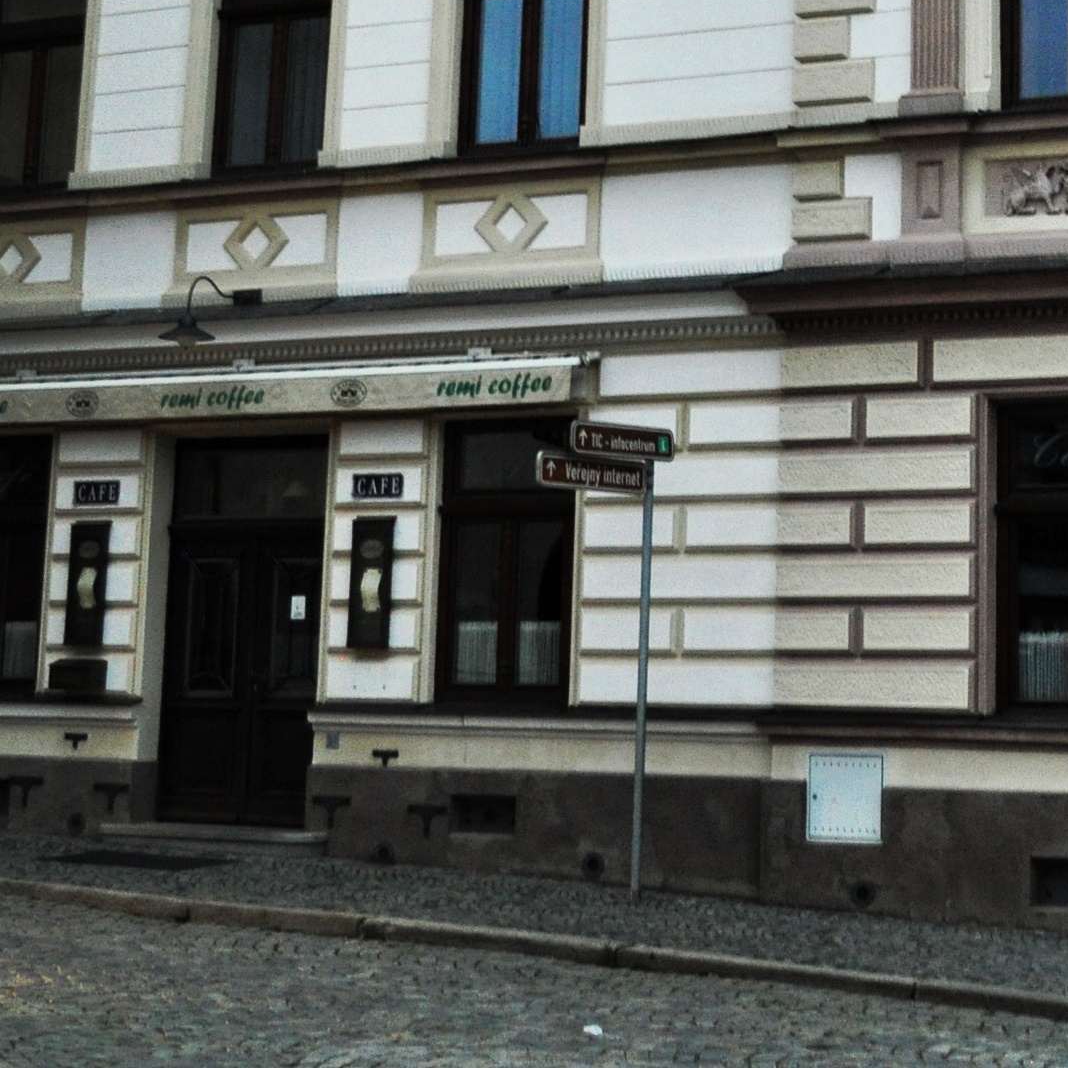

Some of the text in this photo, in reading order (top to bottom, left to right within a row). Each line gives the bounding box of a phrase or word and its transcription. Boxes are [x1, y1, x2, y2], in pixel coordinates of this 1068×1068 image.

[436, 371, 553, 399] remi coffee
[160, 385, 266, 410] remi coffee
[591, 433, 603, 448] TIC
[610, 435, 656, 452] infocentrum
[603, 466, 640, 487] internet
[77, 484, 117, 502] CAFE
[357, 478, 400, 496] CAFE
